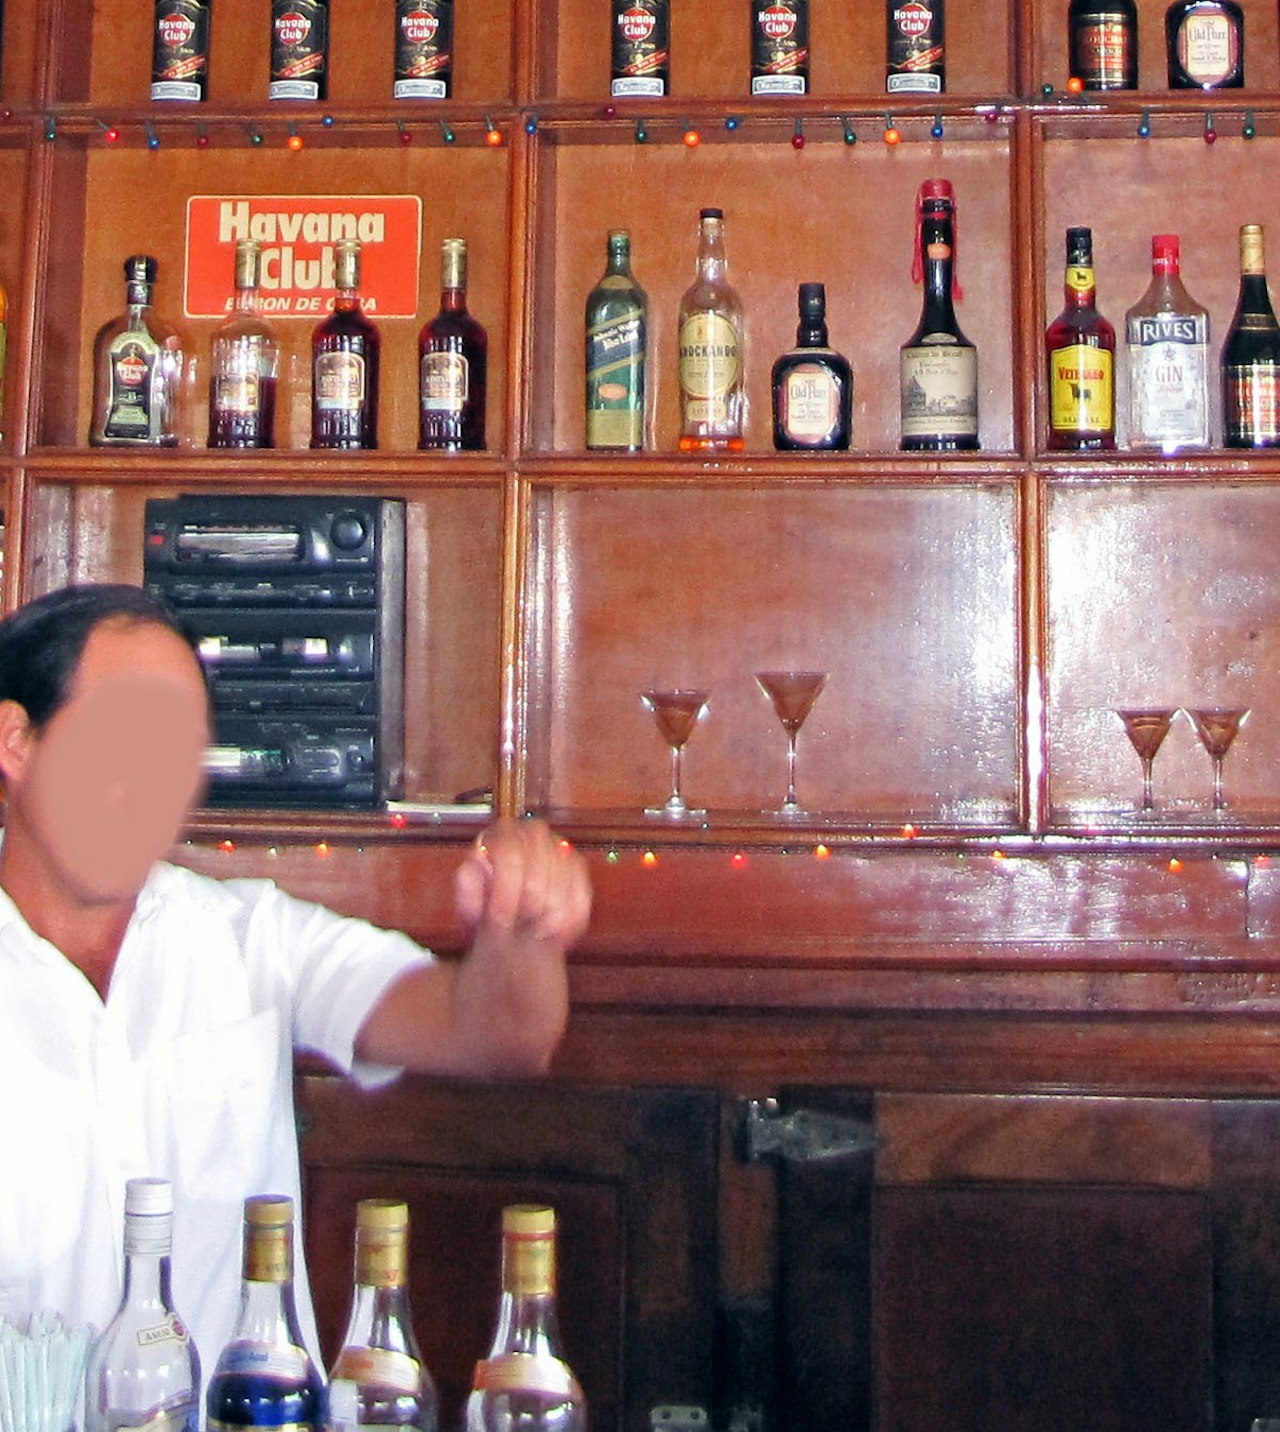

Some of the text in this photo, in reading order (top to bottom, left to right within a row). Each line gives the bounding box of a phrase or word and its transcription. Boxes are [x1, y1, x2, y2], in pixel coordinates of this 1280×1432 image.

[618, 14, 656, 25] Havana
[758, 11, 797, 22] Havana
[893, 10, 933, 20] Havana
[158, 19, 196, 31] Havana
[275, 18, 311, 30] Havana
[401, 17, 439, 27] Havana
[765, 22, 789, 33] Club
[900, 20, 925, 31] Club
[280, 28, 303, 40] Club
[407, 27, 431, 38] Club
[624, 24, 648, 35] Club
[164, 30, 187, 41] Club
[219, 201, 386, 243] Havana
[295, 297, 322, 311] DE
[1143, 322, 1194, 341] RIVES
[1155, 366, 1183, 383] GIN
